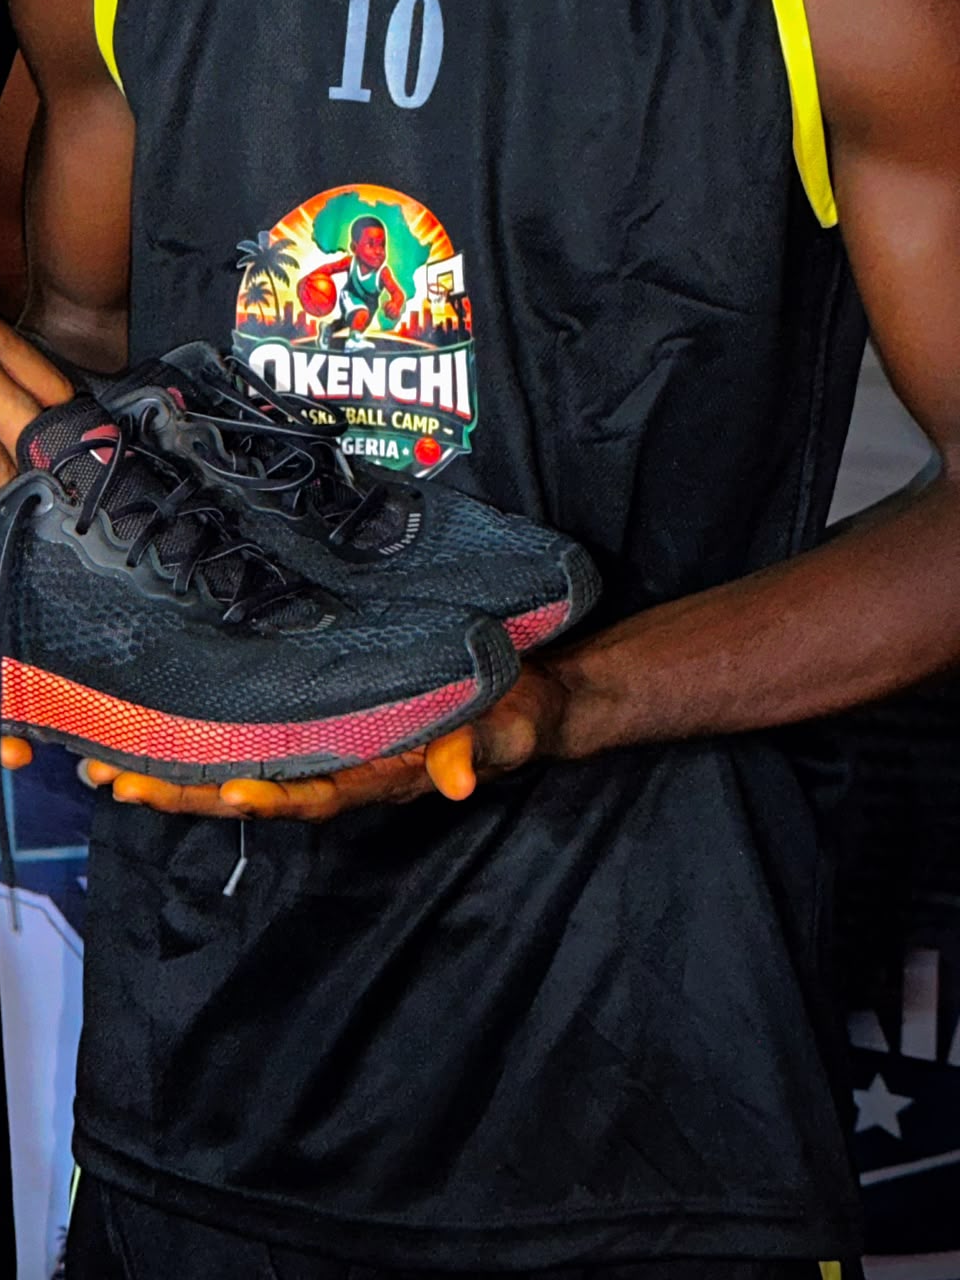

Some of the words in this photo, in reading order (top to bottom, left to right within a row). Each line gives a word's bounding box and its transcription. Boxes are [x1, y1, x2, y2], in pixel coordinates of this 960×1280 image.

[248, 344, 471, 418] OKENCHI
[392, 411, 440, 434] CAMP
[335, 436, 399, 459] GERIA
